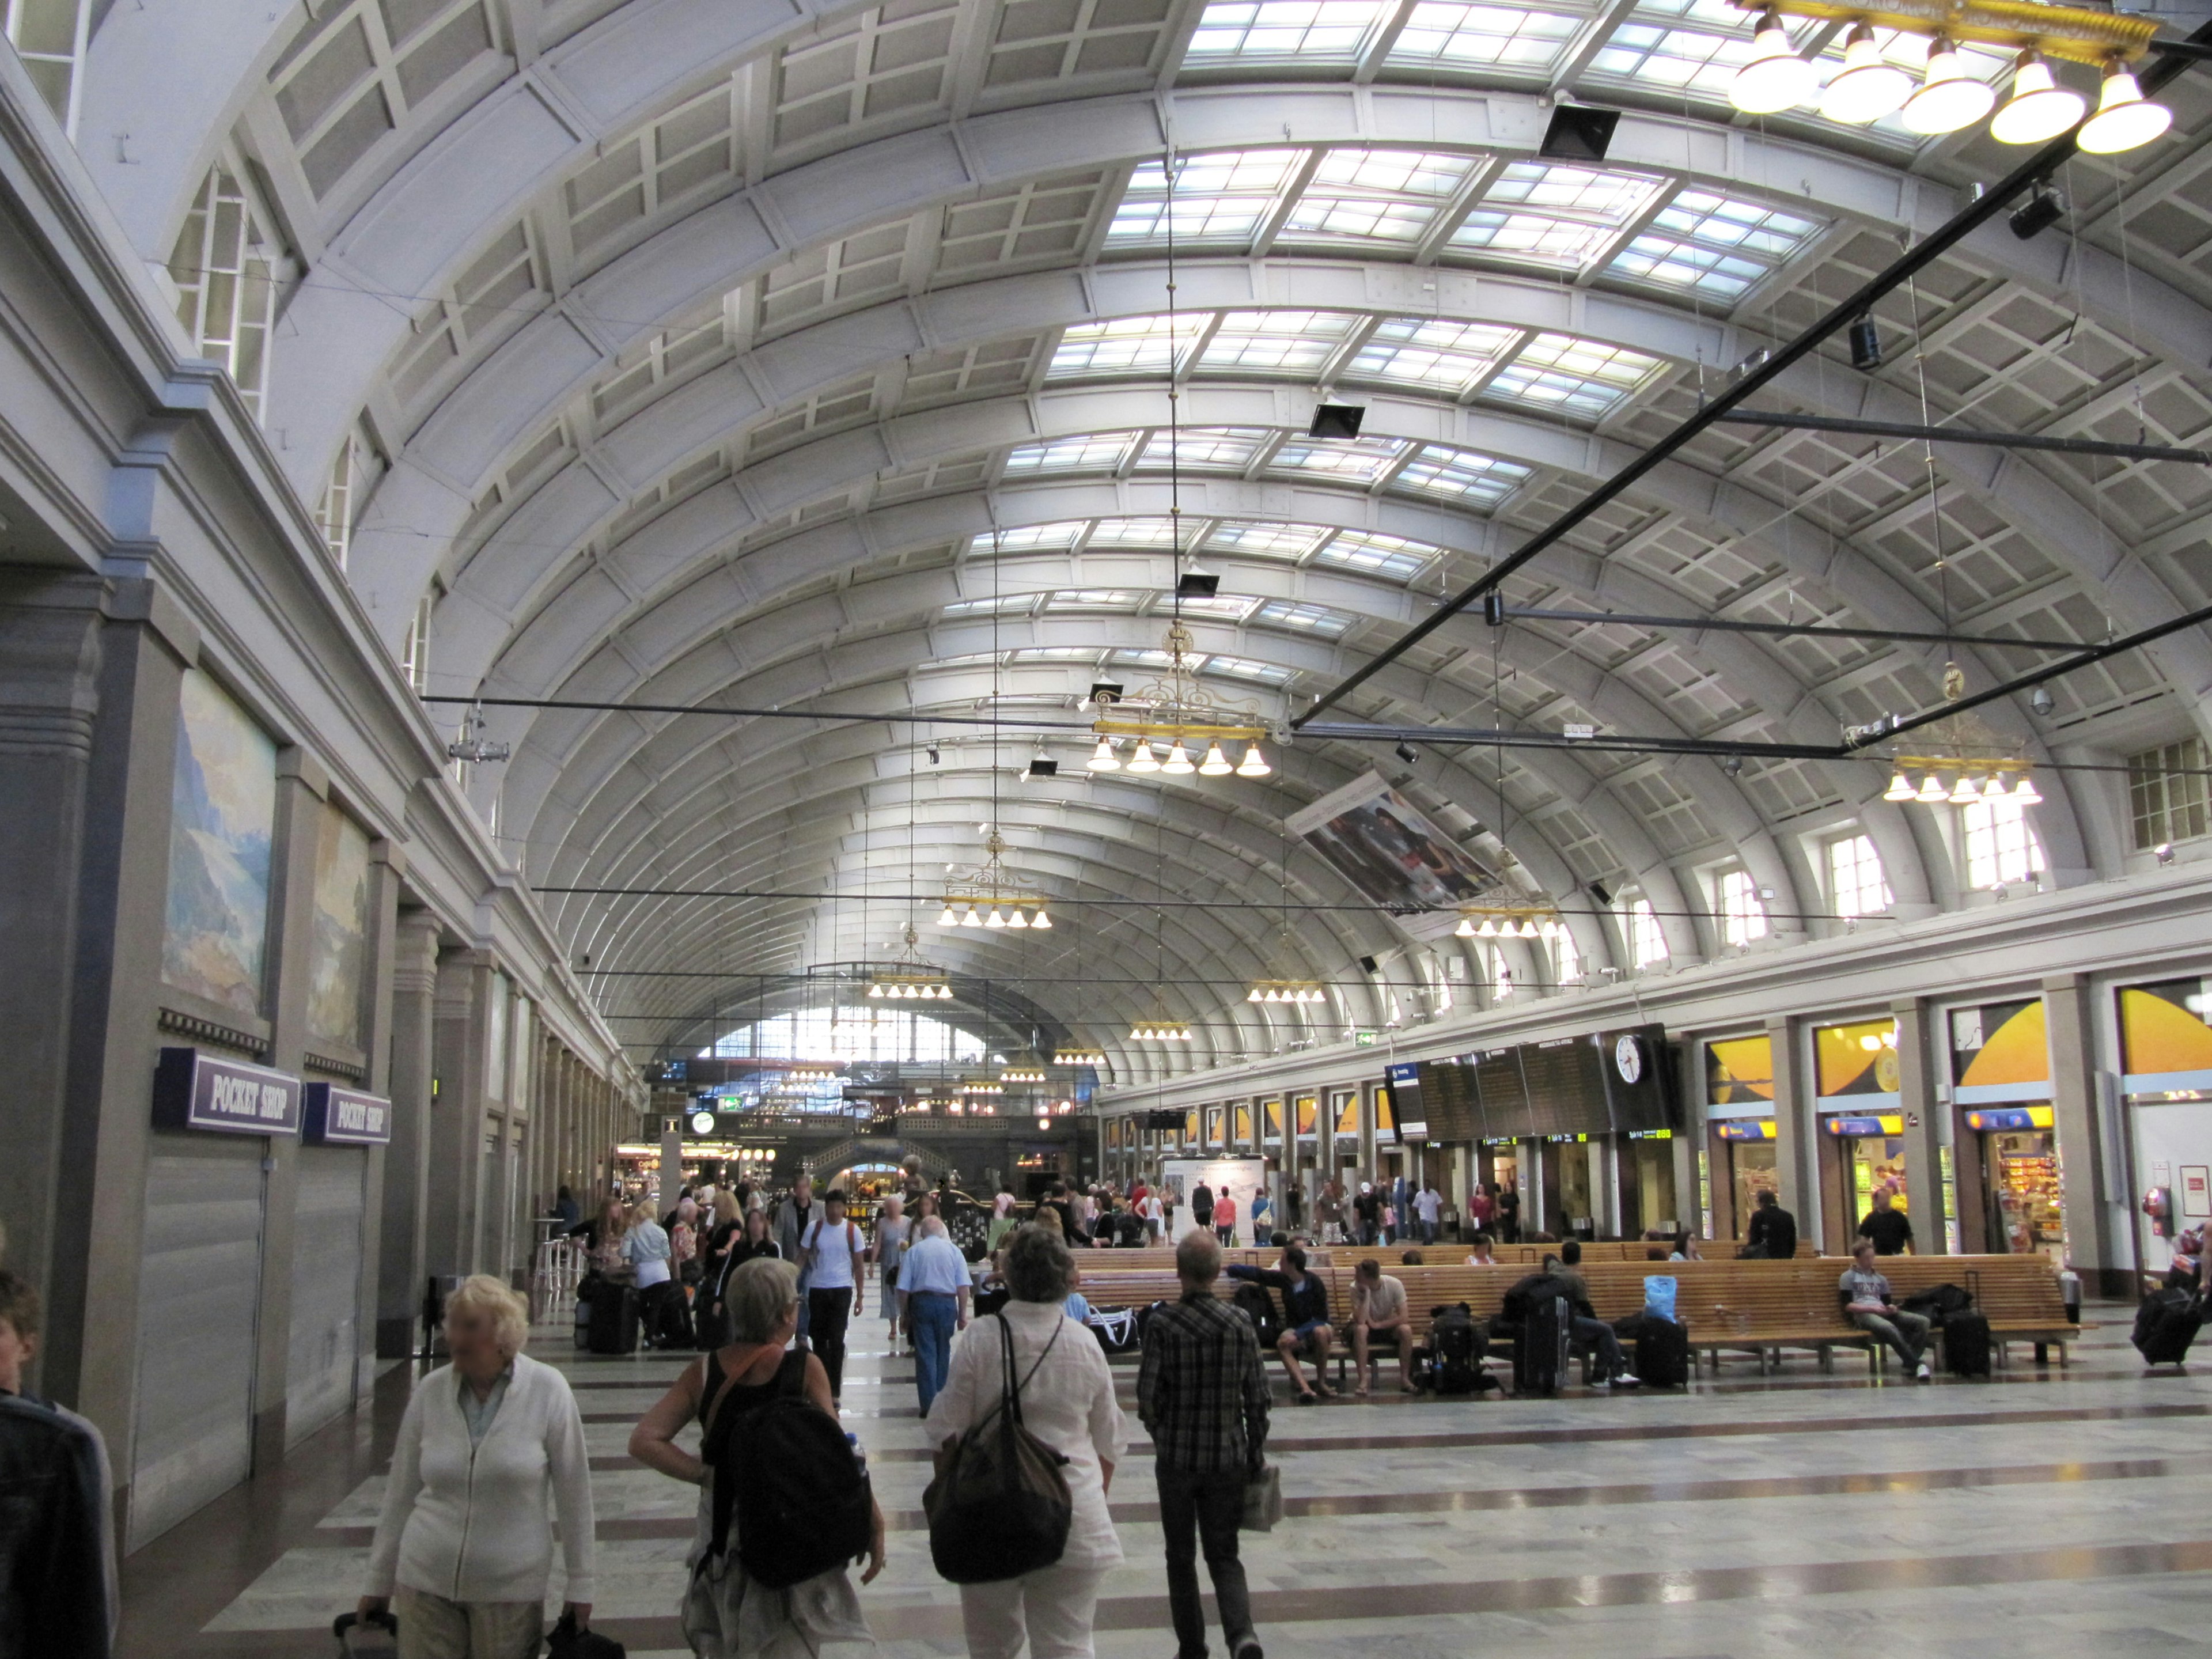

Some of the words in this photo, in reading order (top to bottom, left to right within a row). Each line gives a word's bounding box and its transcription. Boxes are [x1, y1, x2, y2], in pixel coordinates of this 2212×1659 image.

[210, 1074, 260, 1116] POCKET
[260, 1084, 287, 1120] SHOP
[337, 1101, 366, 1130] POCKET
[366, 1107, 384, 1133] SHOP
